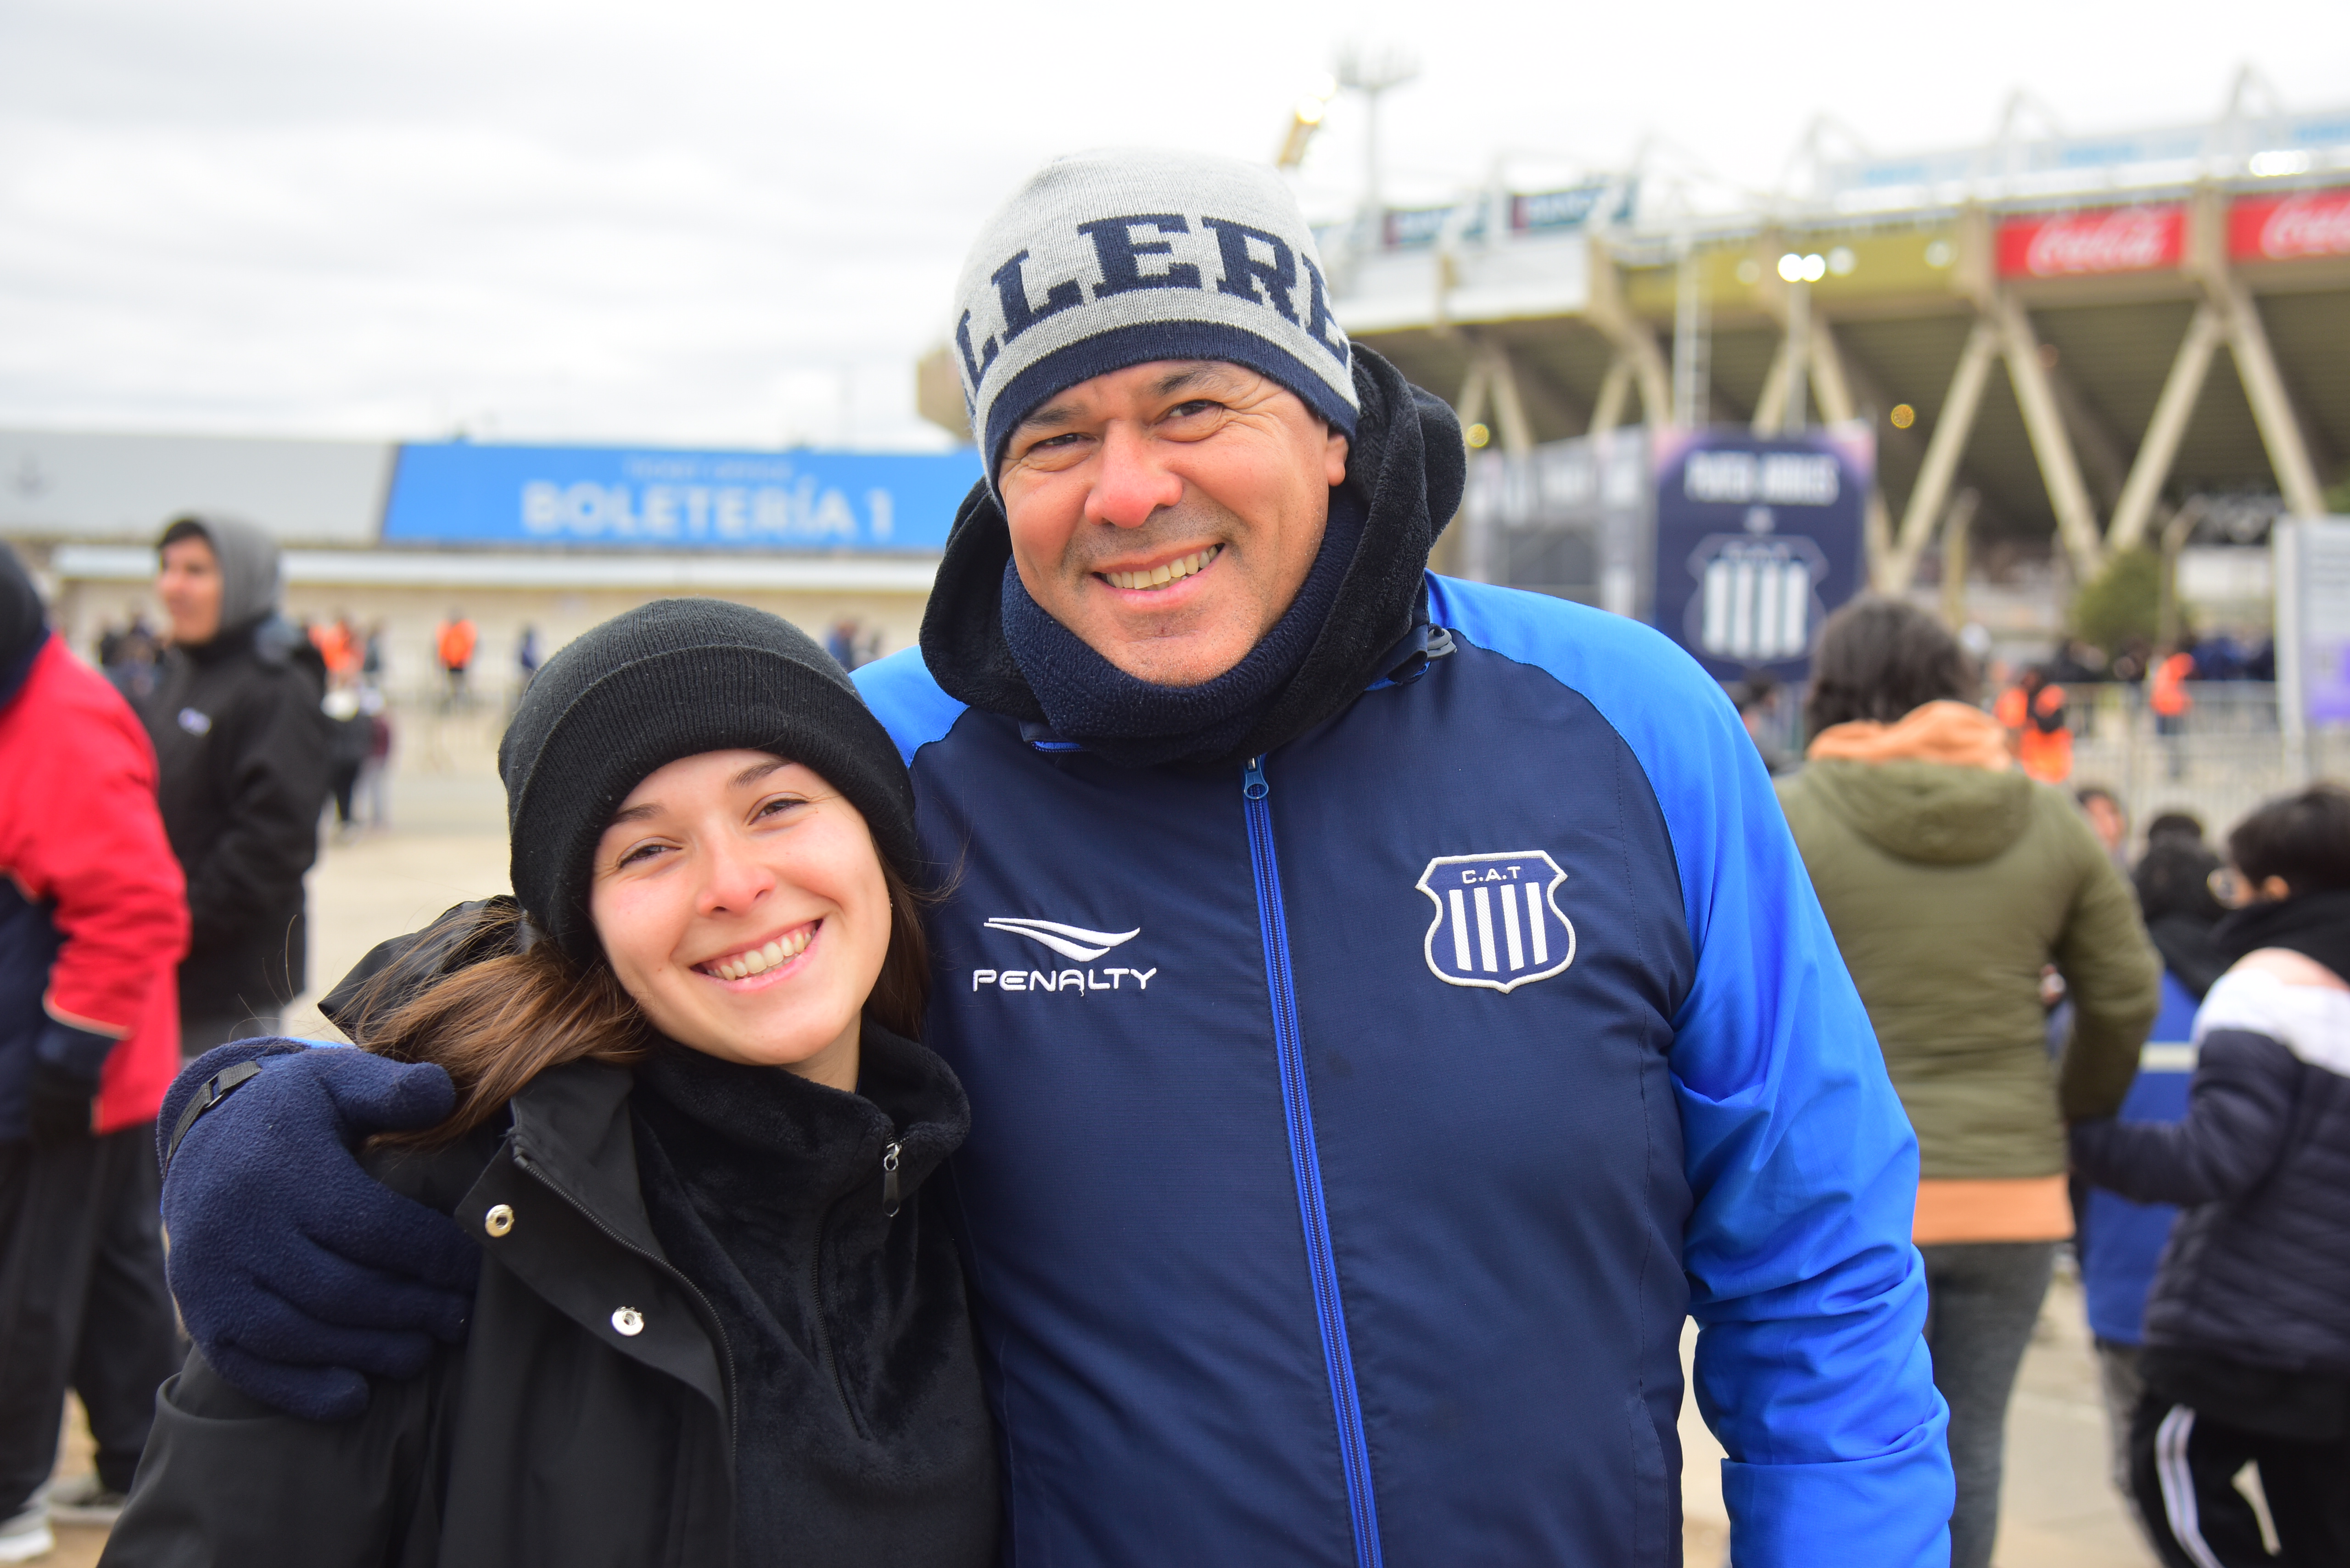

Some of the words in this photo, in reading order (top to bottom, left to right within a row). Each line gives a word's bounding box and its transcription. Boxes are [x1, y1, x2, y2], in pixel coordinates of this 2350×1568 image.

[522, 475, 856, 538] BOLETERÍA
[866, 488, 894, 540] 1
[972, 966, 1157, 992] PENALTY
